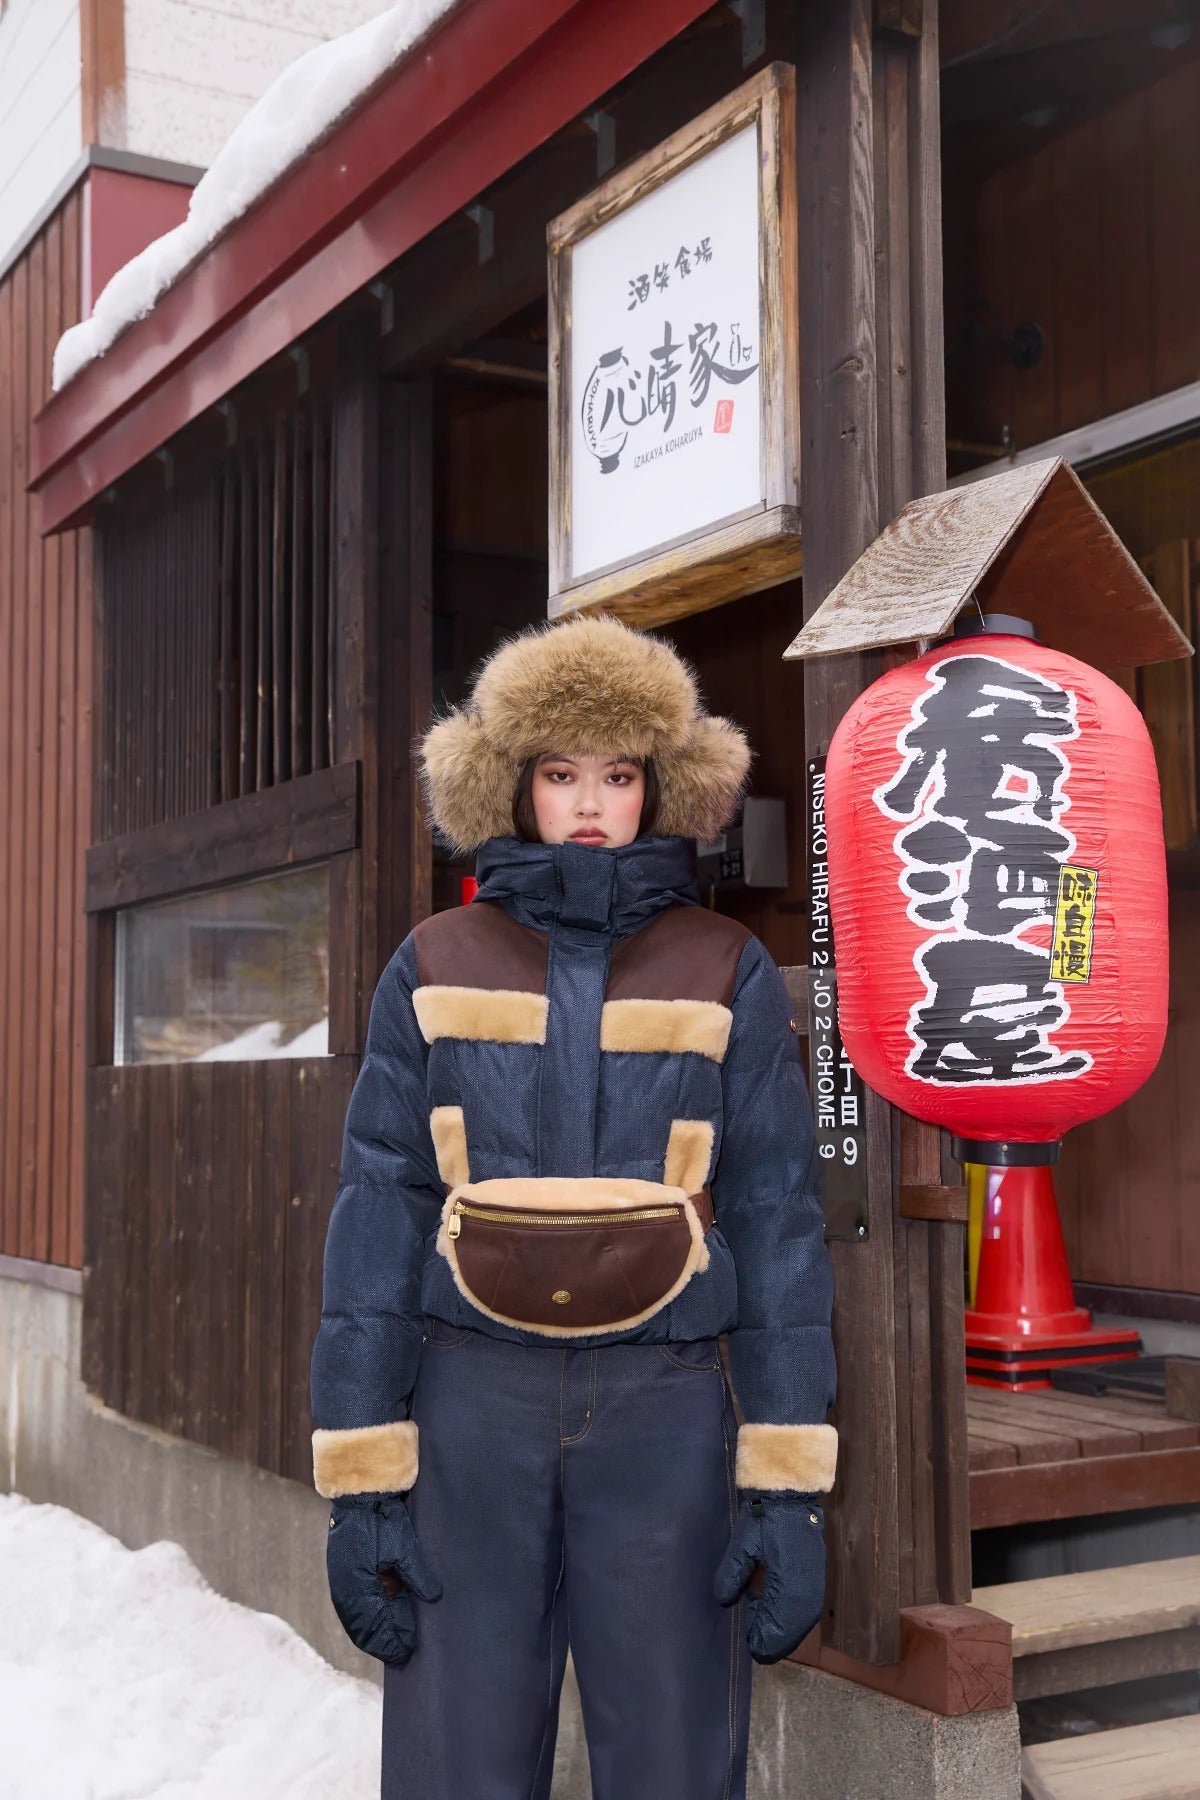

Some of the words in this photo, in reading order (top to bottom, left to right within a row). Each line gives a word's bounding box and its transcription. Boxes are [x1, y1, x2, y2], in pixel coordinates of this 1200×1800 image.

[587, 376, 600, 451] KOHARUYA
[633, 446, 663, 469] IZAKAYA
[665, 426, 704, 454] KOHARUYA
[812, 773, 828, 855] NISEKO
[811, 861, 829, 943] HIRAFU
[875, 656, 1092, 1086] 居酒屋
[1054, 872, 1093, 979] 味自慢
[818, 1143, 836, 1160] 9
